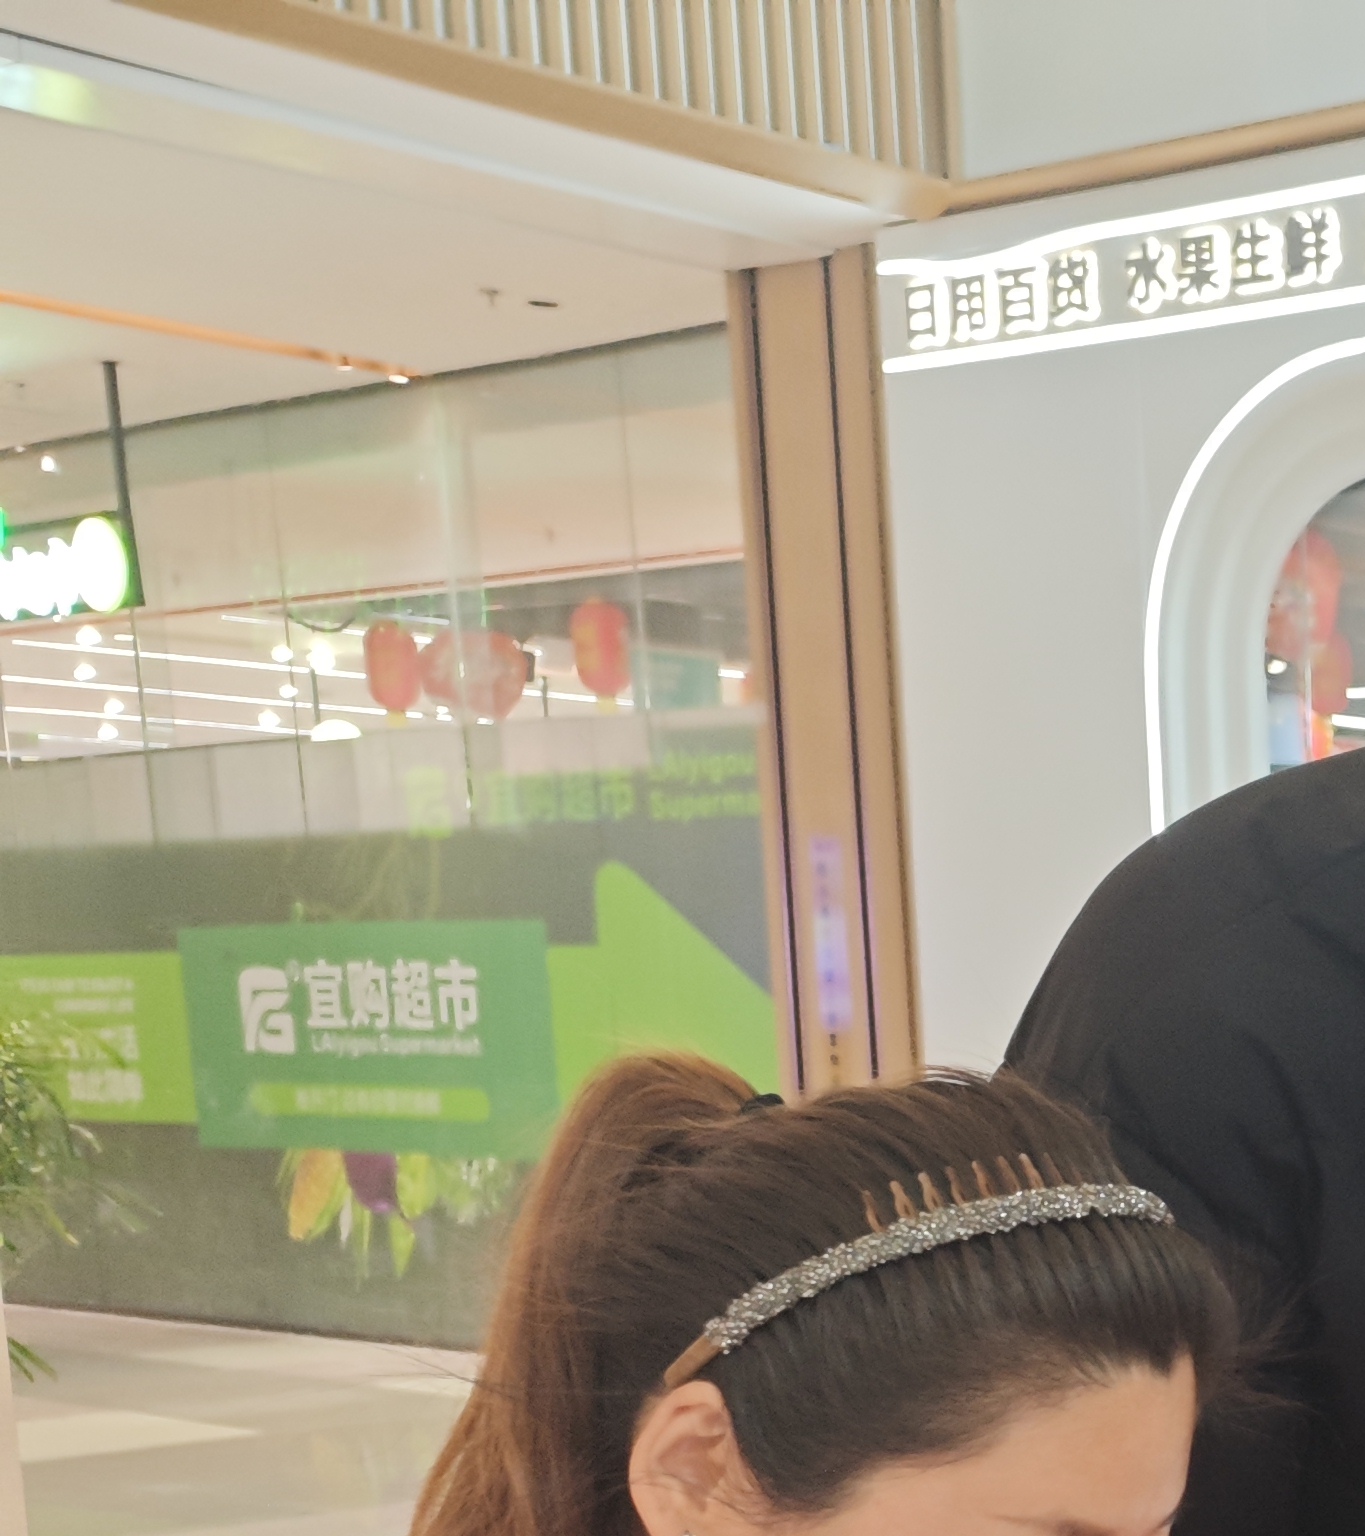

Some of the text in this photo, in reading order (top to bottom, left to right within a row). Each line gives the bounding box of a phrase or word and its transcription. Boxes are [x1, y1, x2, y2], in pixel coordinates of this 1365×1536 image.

[905, 248, 1101, 350] 日用百货
[1125, 206, 1344, 312] 水果生鲜
[303, 958, 478, 1031] 宜购超市
